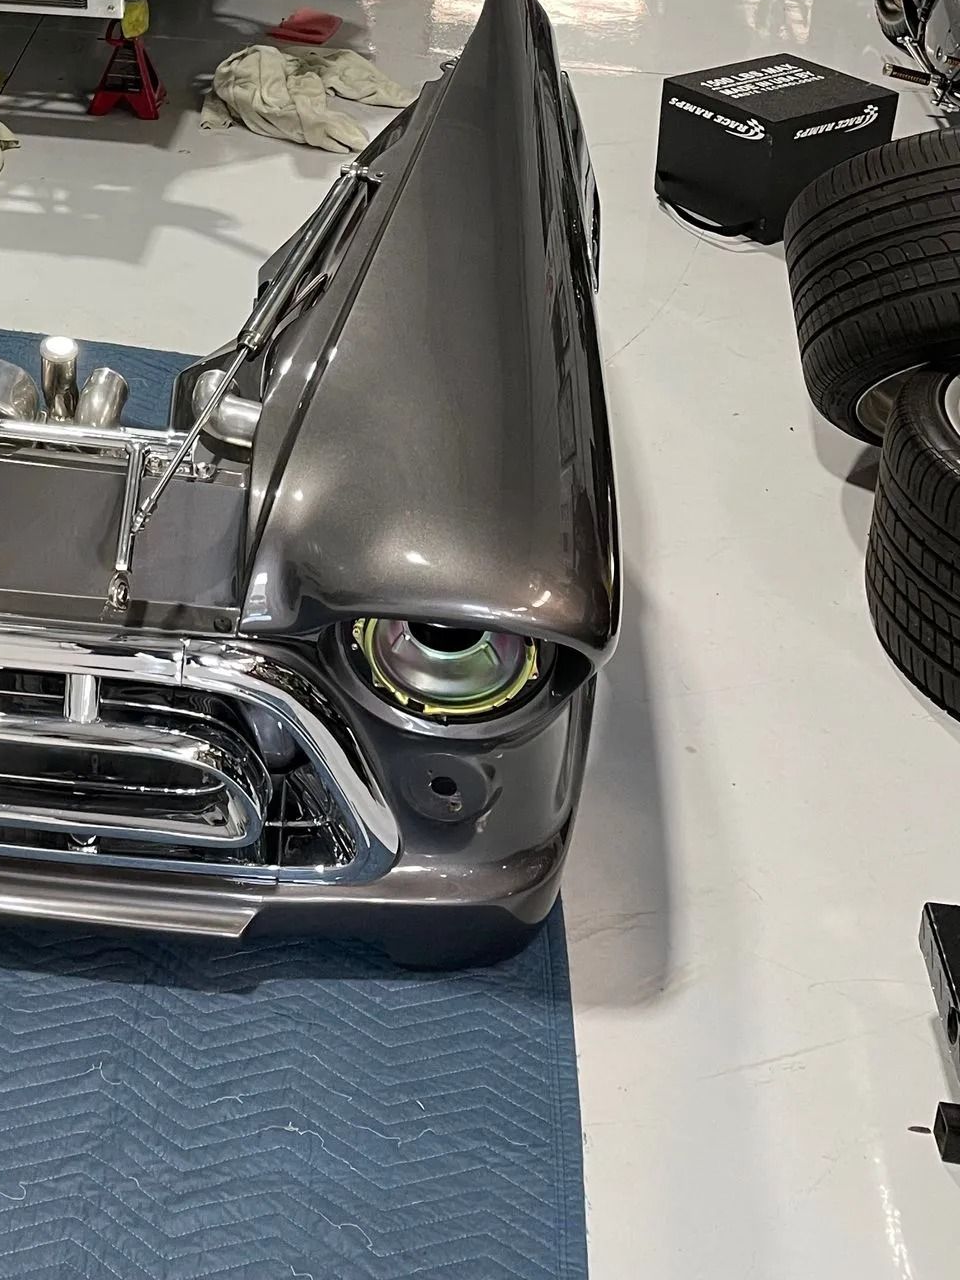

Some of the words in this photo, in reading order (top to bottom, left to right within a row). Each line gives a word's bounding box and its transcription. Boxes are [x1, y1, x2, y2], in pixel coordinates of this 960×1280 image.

[700, 76, 735, 88] 1500
[719, 83, 760, 96] MADE
[755, 79, 773, 88] IN
[768, 73, 801, 85] USA
[795, 70, 816, 79] BY
[668, 96, 714, 120] RAMPS
[715, 114, 749, 133] RACE
[793, 122, 836, 140] RAMPS
[836, 114, 864, 130] RACE
